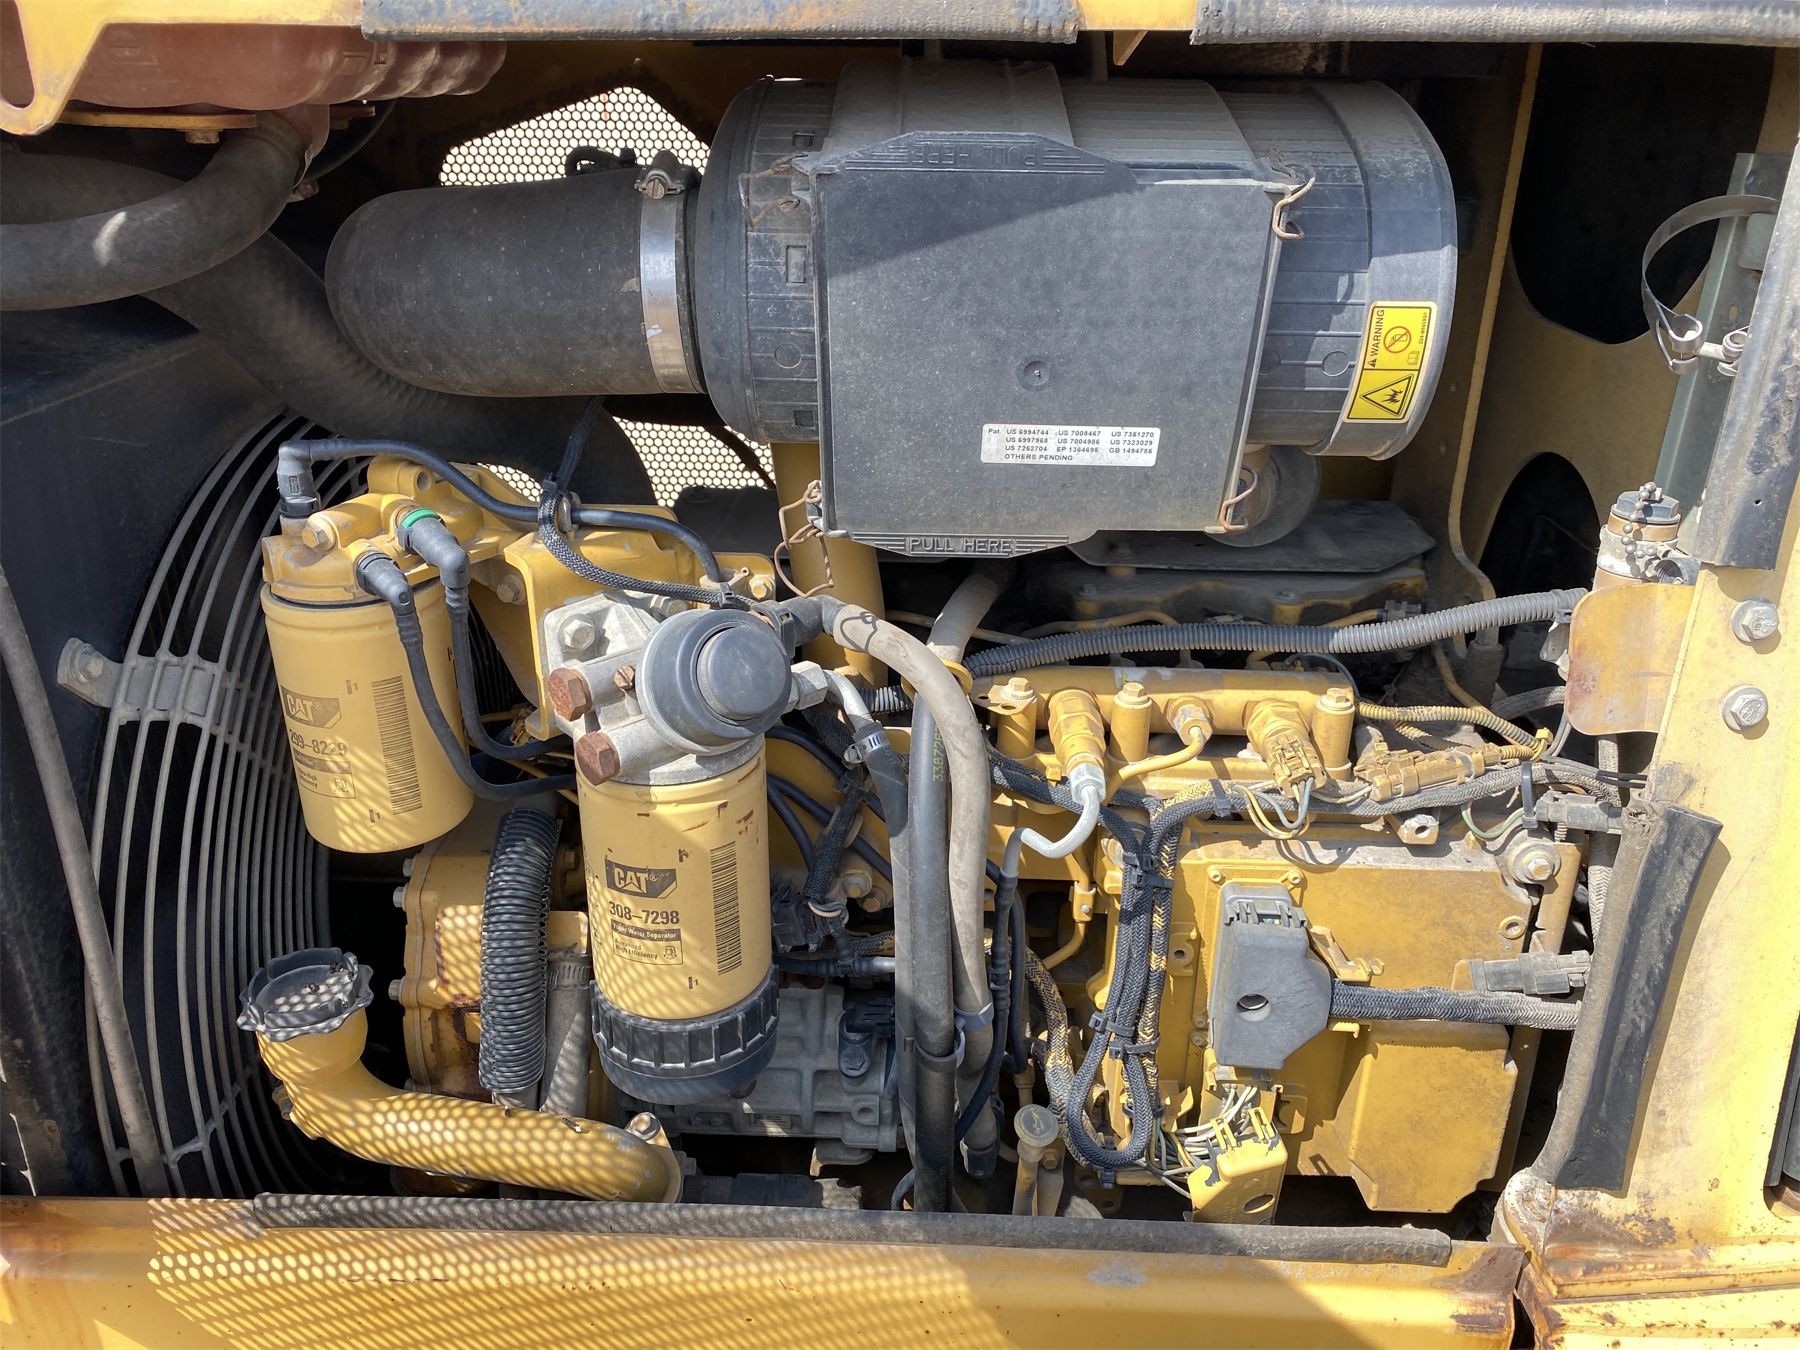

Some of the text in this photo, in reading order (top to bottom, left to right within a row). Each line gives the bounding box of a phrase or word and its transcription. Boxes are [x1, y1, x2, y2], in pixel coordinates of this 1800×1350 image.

[911, 145, 1036, 166] PULL HERE
[1370, 309, 1385, 357] WARNING
[909, 538, 1012, 552] PULL HERE
[286, 694, 315, 722] CAT
[613, 867, 649, 893] CAT
[609, 900, 680, 925] 308-7298
[646, 929, 677, 940] Separator
